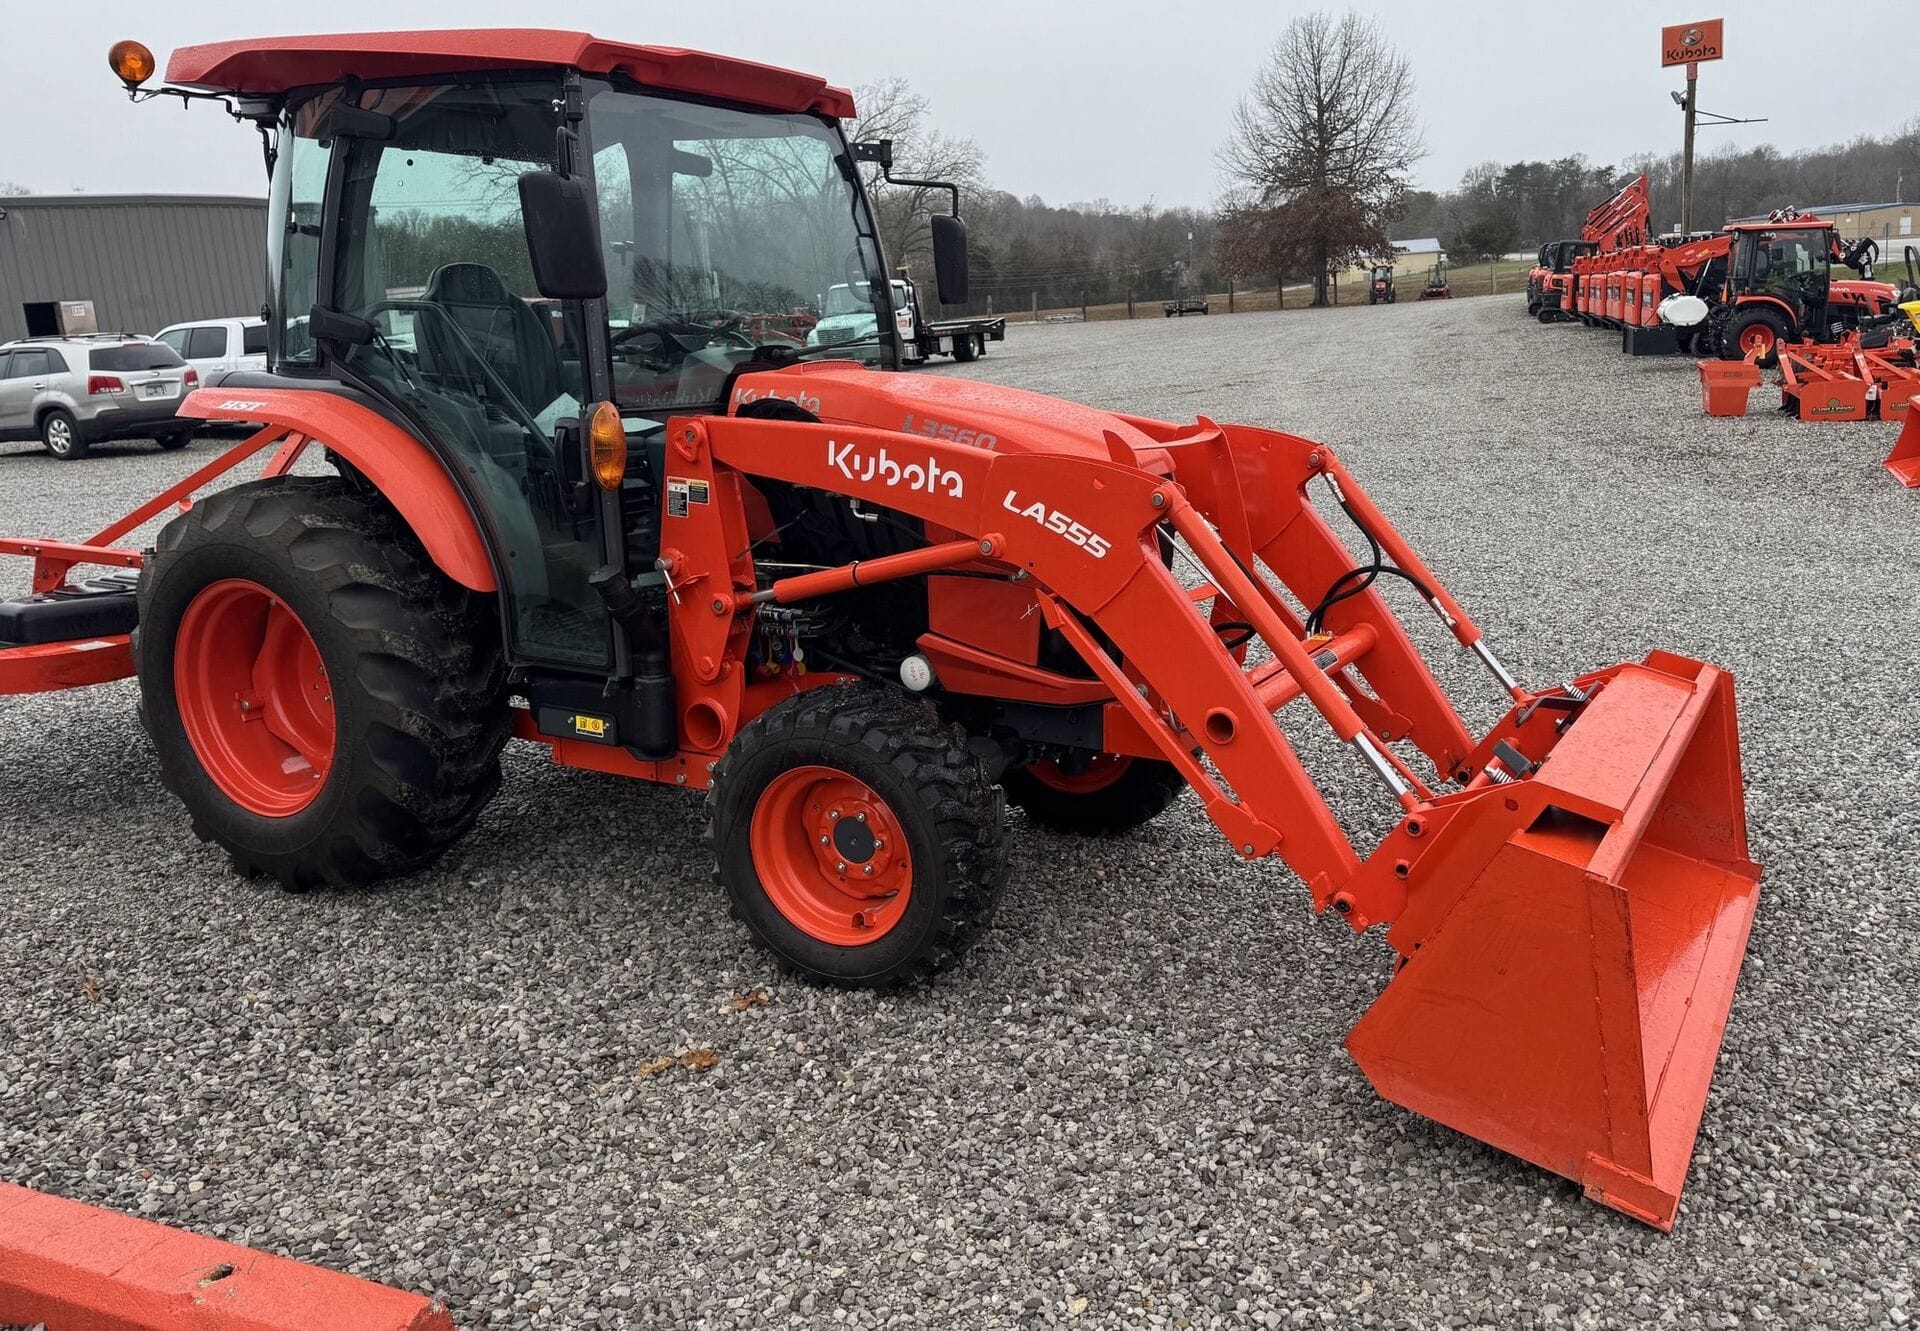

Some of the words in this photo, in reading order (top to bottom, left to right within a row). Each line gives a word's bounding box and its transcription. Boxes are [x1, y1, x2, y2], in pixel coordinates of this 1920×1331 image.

[1667, 45, 1716, 60] Kubota
[903, 414, 998, 451] L3560
[828, 440, 963, 498] Kubota
[1002, 490, 1112, 558] LA555
